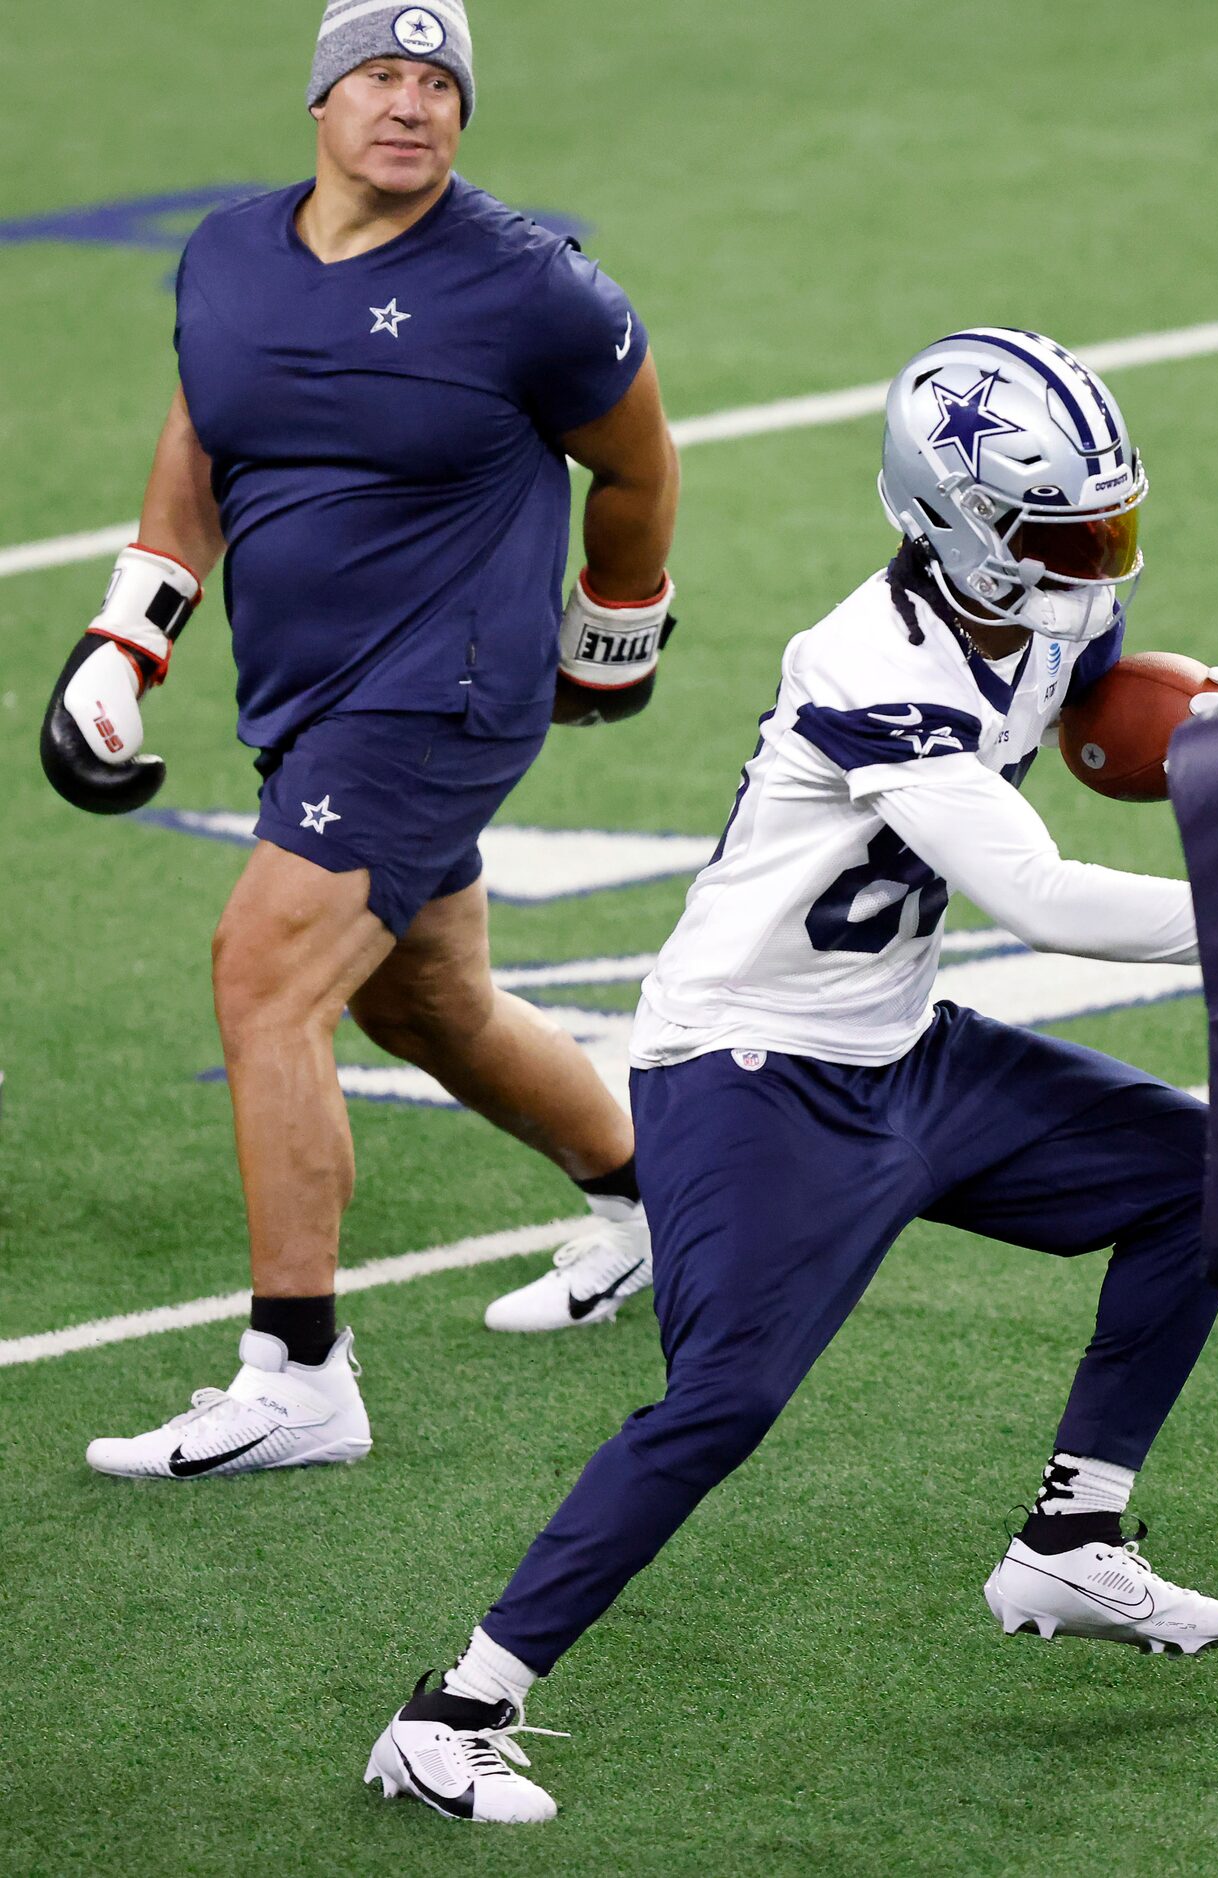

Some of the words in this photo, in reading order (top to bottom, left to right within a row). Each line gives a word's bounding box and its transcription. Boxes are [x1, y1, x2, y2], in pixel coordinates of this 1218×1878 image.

[1095, 472, 1128, 491] COWBOYS
[581, 632, 650, 662] TITLE
[93, 700, 124, 753] GEL
